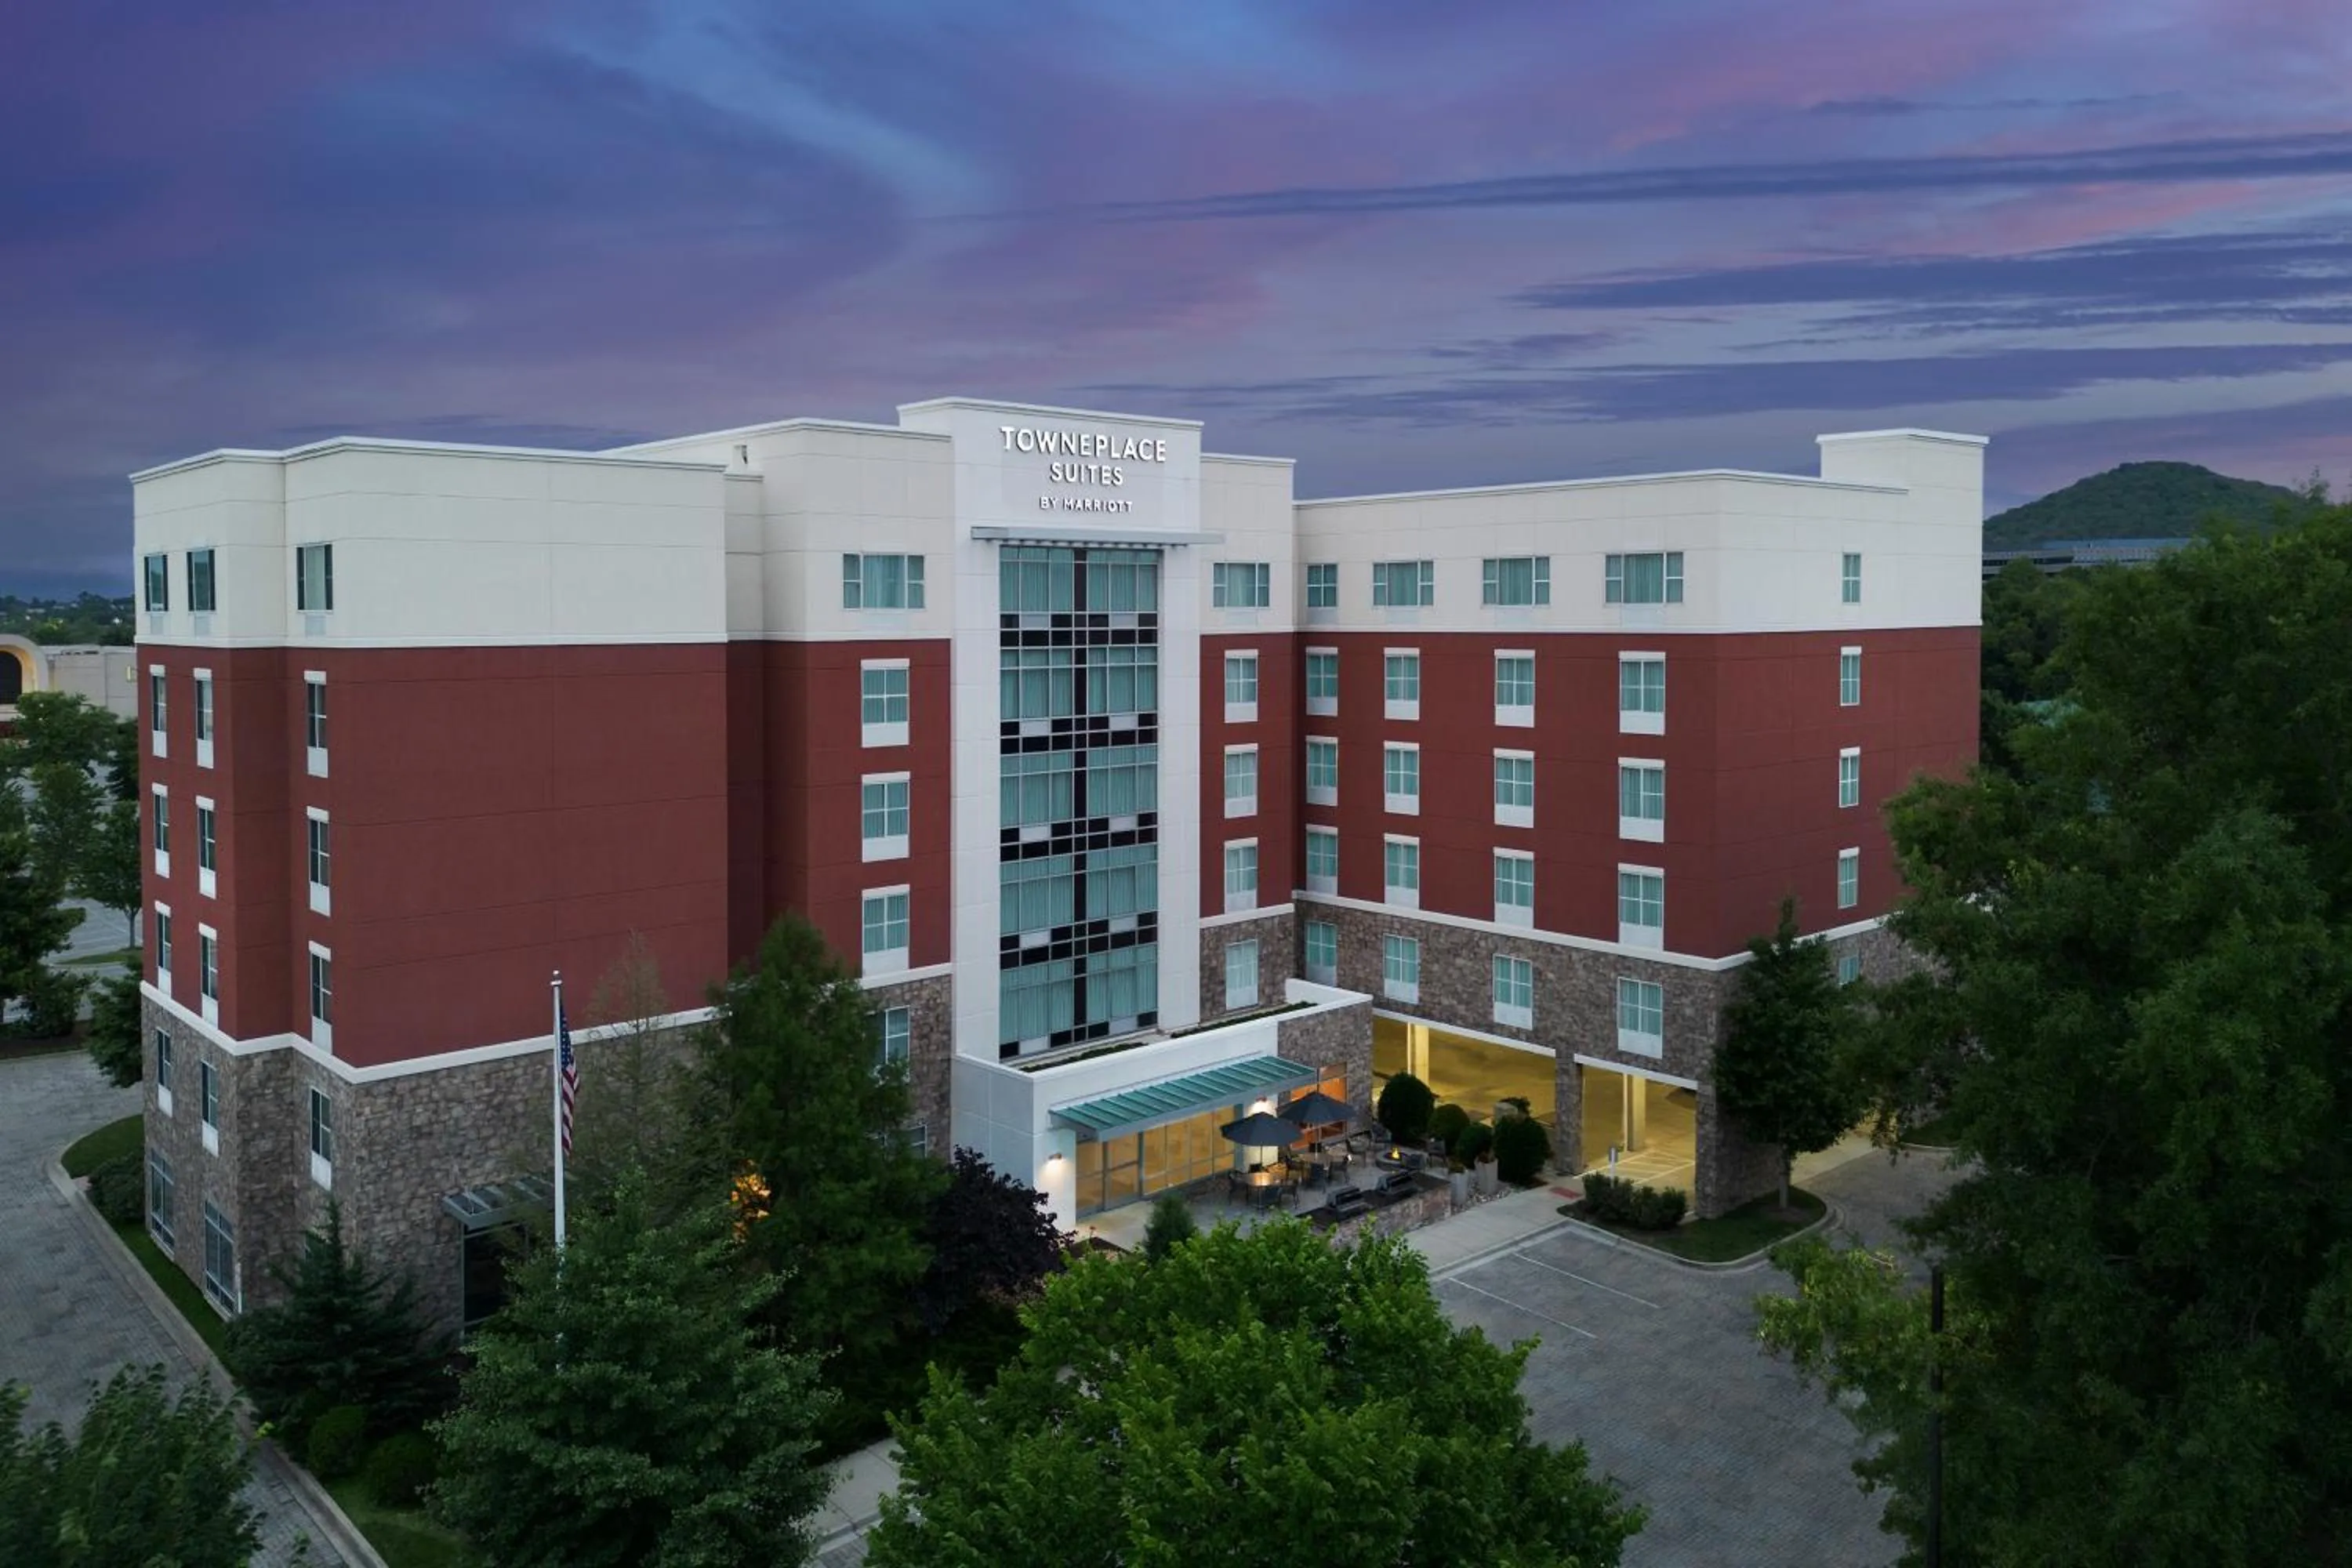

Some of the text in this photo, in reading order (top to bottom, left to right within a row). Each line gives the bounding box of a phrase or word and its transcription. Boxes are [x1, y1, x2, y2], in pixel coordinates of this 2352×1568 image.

[1000, 426, 1167, 462] TOWNEPLACE
[1050, 462, 1124, 486] SUITES
[1040, 496, 1134, 513] BY MARRIOTT
